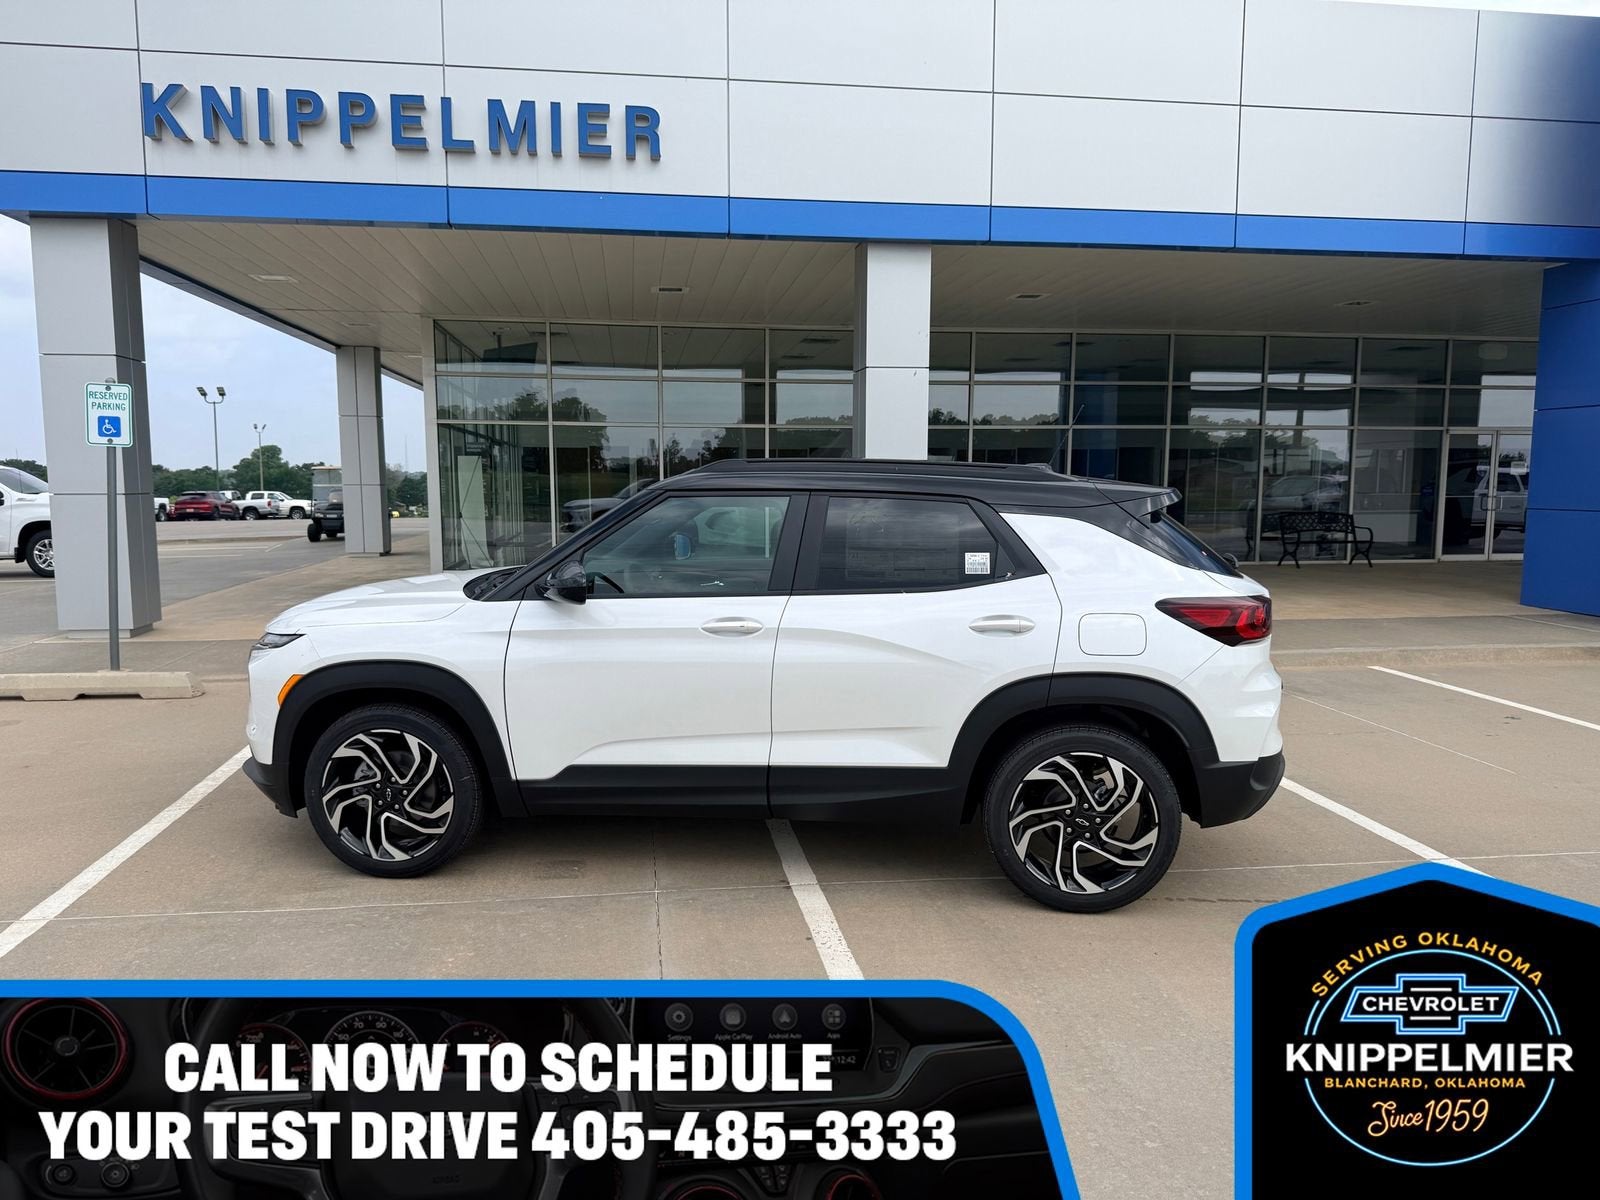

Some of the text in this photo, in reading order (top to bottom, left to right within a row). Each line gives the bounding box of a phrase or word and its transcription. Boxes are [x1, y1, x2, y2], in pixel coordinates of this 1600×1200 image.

[141, 82, 662, 161] KNIPPELMIER
[89, 391, 128, 400] RESERVED
[91, 402, 126, 411] PARKING
